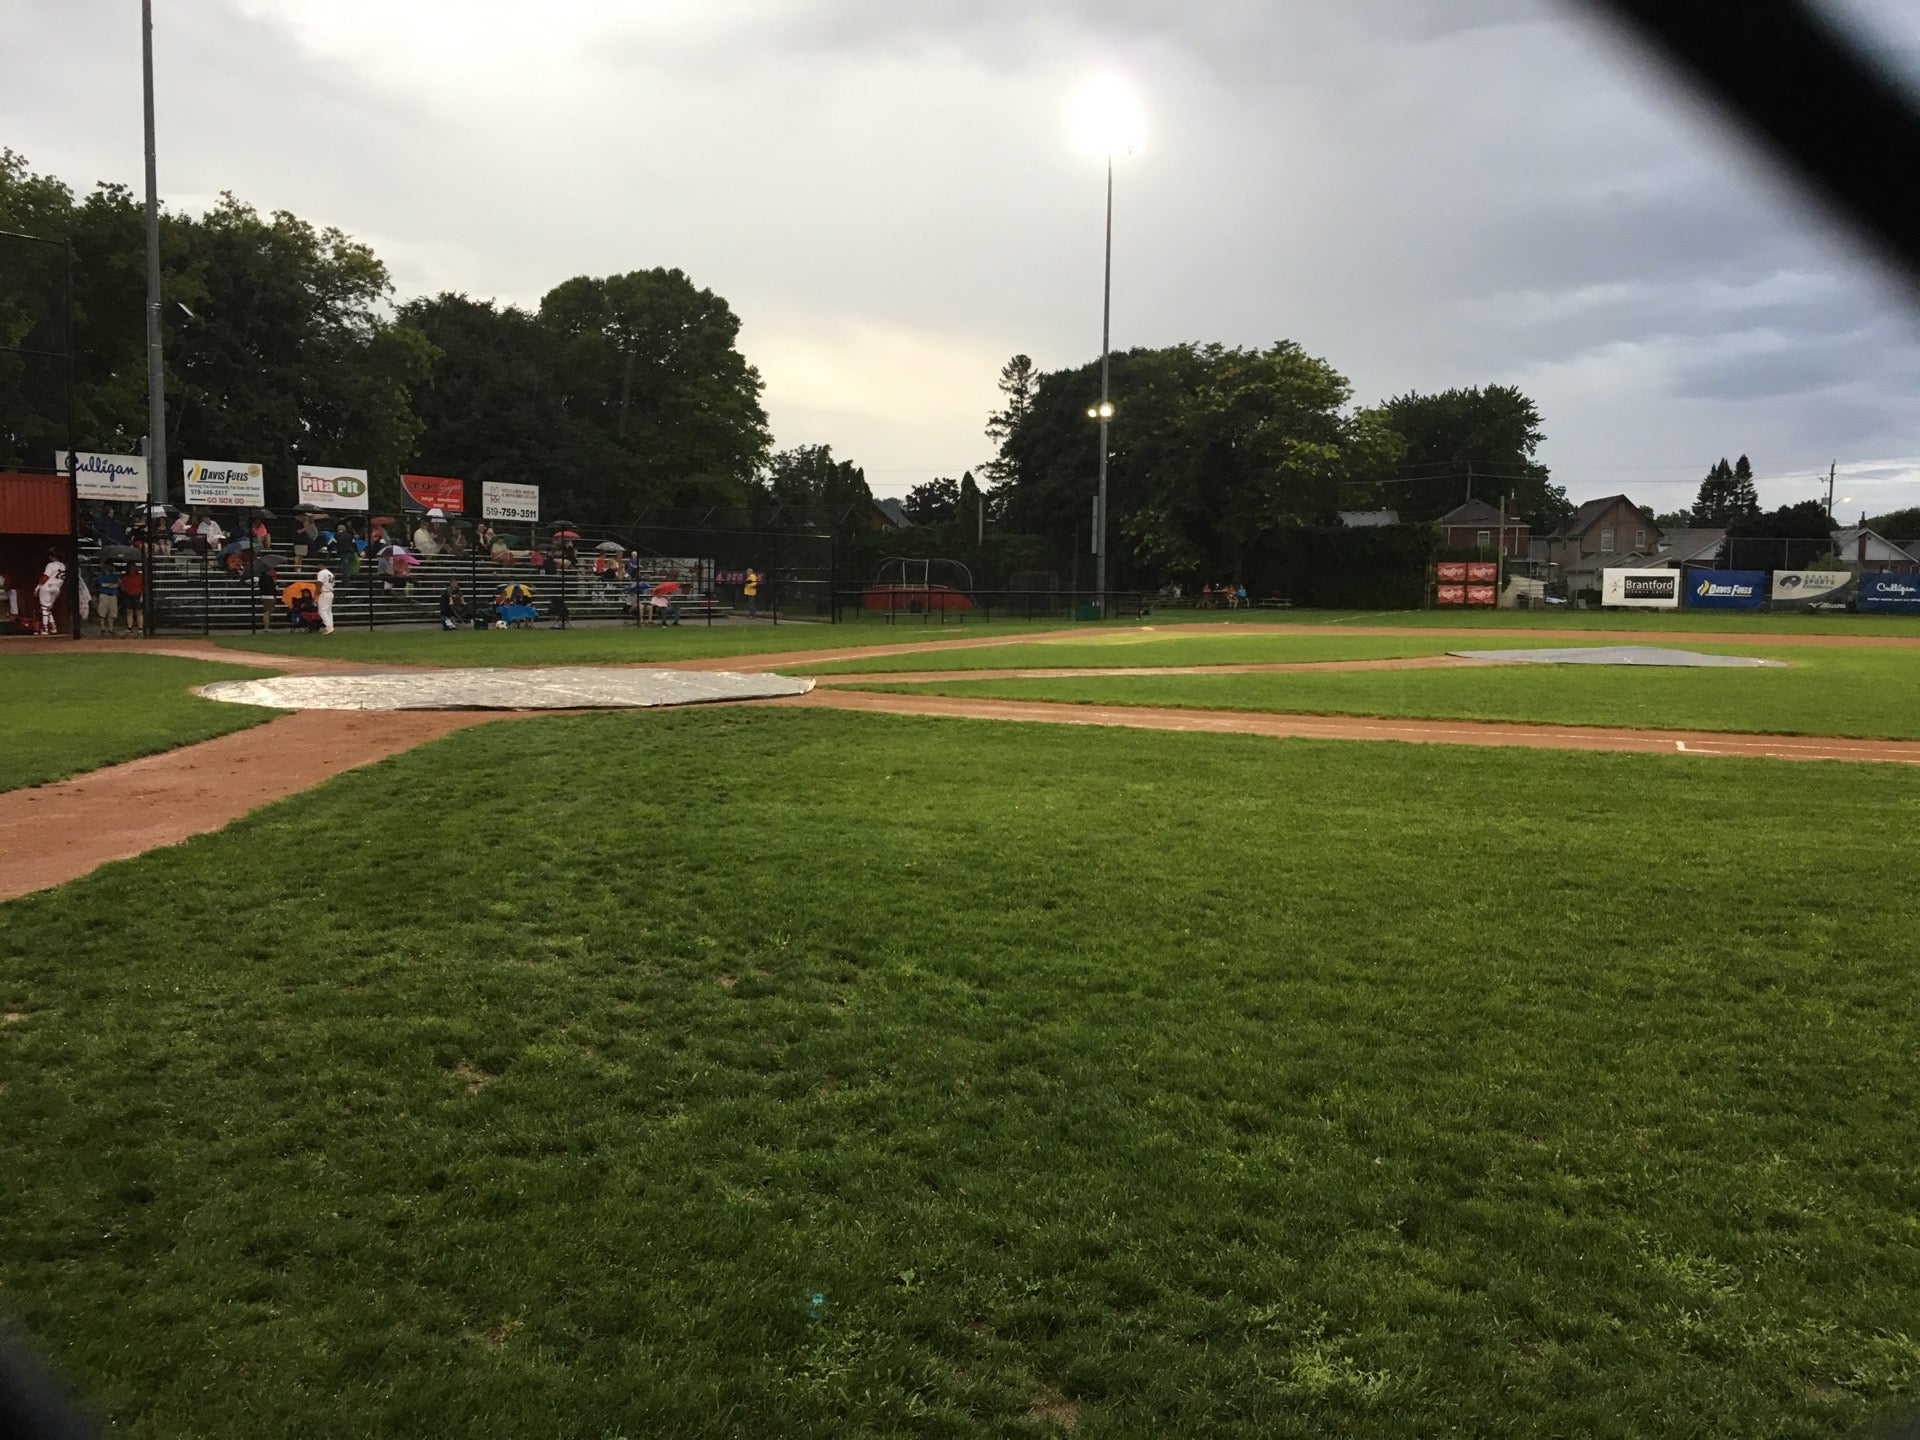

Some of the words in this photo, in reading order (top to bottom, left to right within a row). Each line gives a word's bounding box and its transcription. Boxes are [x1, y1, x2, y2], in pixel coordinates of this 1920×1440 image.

[64, 456, 138, 482] Culligan
[302, 477, 333, 492] Pita
[337, 480, 360, 493] Pit
[1626, 580, 1673, 590] Brantford
[1876, 583, 1917, 596] Culligan
